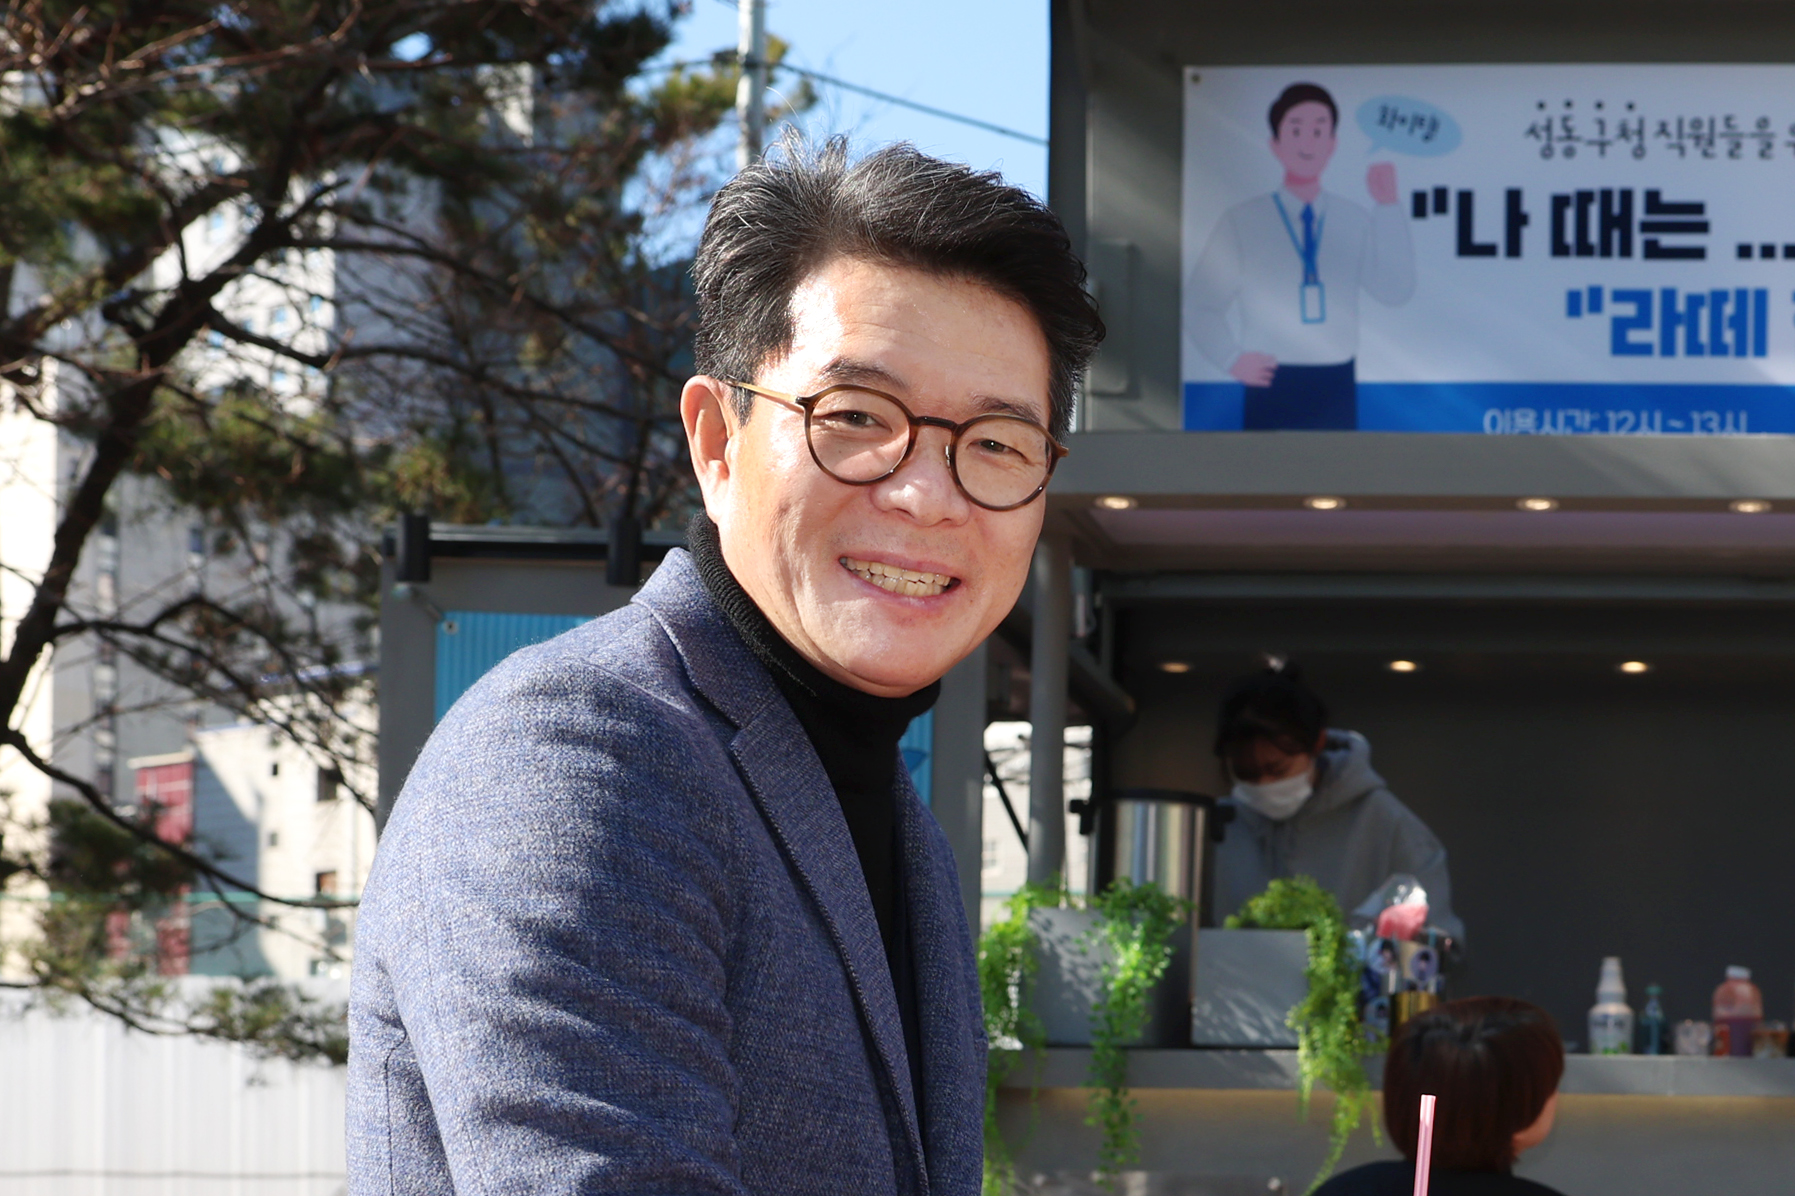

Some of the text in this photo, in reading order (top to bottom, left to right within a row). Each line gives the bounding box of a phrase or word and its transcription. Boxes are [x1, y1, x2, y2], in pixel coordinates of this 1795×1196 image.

[1525, 114, 1646, 160] 성동구청
[1654, 115, 1776, 160] 직원들을
[1550, 187, 1710, 260] 때는
